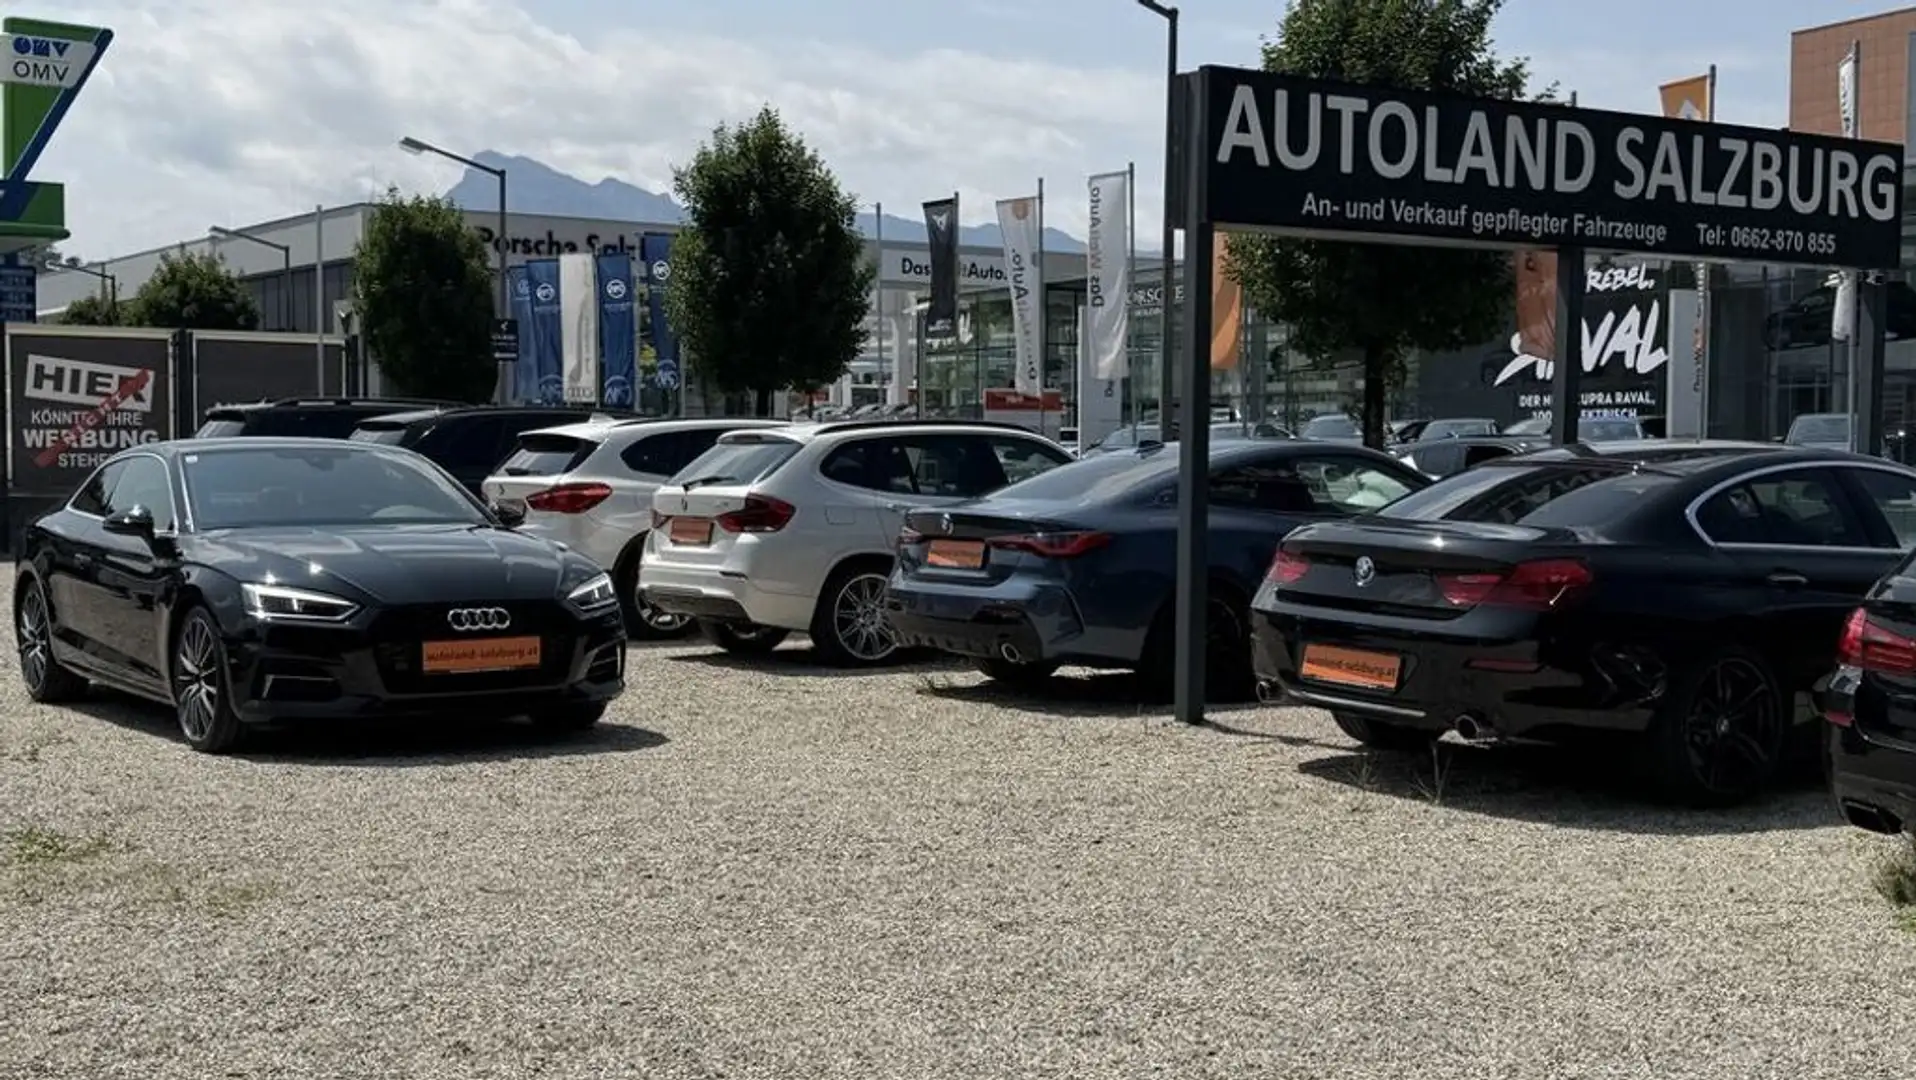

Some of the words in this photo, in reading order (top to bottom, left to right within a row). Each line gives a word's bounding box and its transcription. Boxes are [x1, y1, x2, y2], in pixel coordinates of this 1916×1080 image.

[13, 60, 69, 81] OMV
[1217, 84, 1596, 194] AUTOLAND
[1613, 126, 1897, 221] SALZBURG
[1301, 192, 1341, 217] An-
[1345, 198, 1384, 221] und
[1390, 199, 1468, 227] Verkauf
[1472, 205, 1569, 236] gepflegter
[1573, 213, 1667, 246] Fahrzeuge
[1696, 223, 1726, 246] Tel:
[1731, 228, 1803, 251] 0662-870
[1807, 231, 1837, 254] 855
[901, 257, 932, 276] Das
[1519, 394, 1541, 407] DER
[1578, 391, 1613, 406] UPRA
[22, 428, 160, 449] WERBUNG
[58, 452, 111, 468] STEHE
